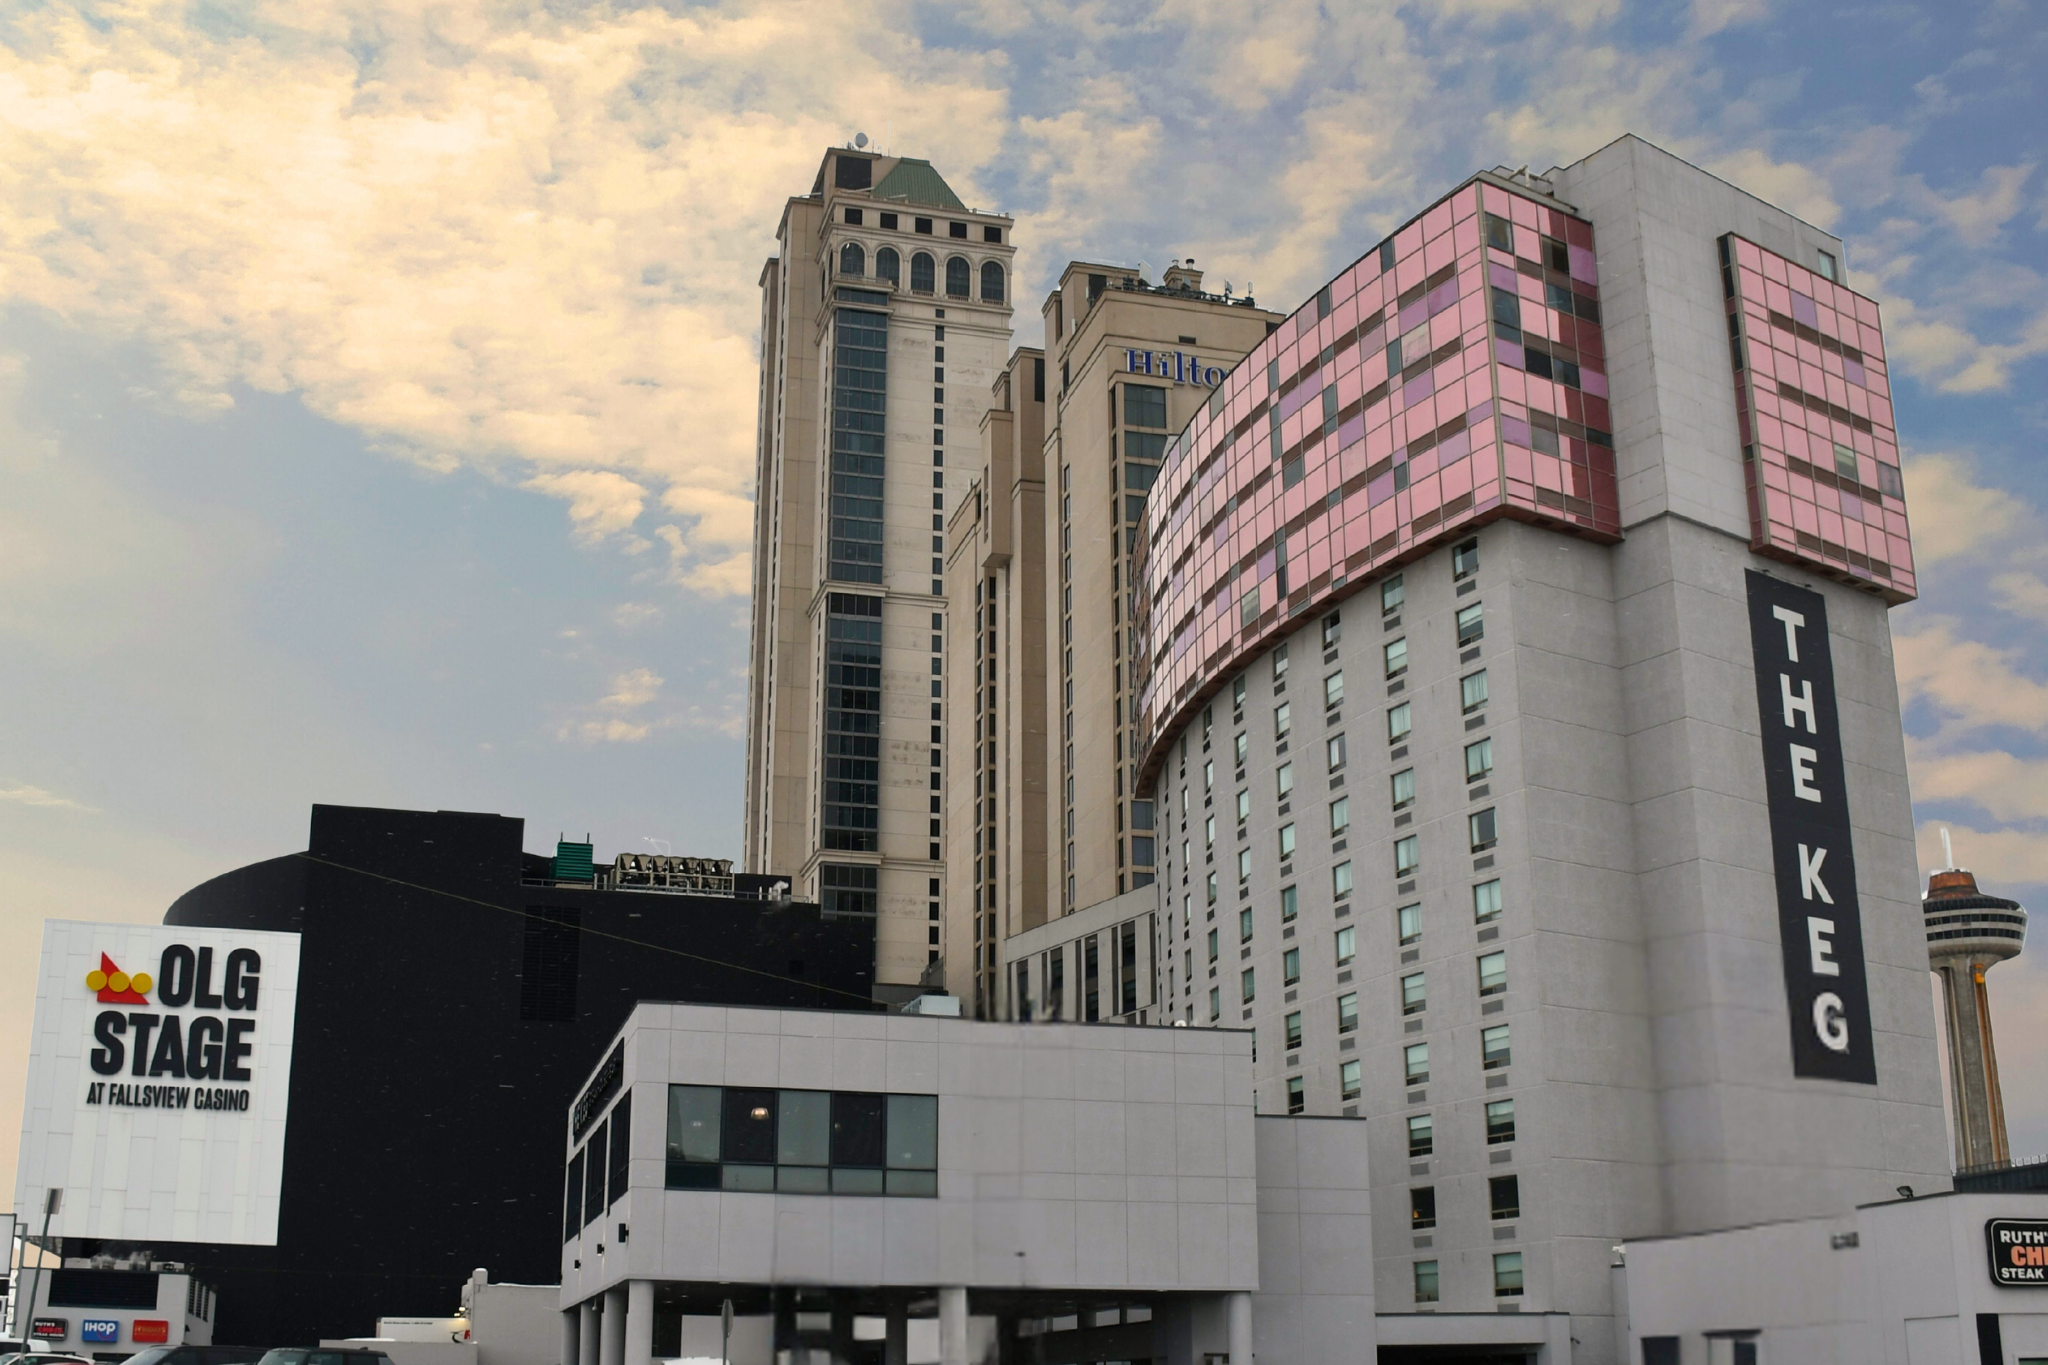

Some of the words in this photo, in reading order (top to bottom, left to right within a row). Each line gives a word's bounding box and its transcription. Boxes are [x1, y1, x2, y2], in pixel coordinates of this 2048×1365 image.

[1124, 349, 1231, 390] Hilto
[1772, 604, 1822, 803] THE
[1798, 843, 1850, 1053] KEG
[158, 944, 261, 1010] OLG
[90, 1010, 256, 1082] STAGE
[86, 1082, 106, 1104] AT
[108, 1083, 191, 1109] FALLSVIEW
[194, 1086, 250, 1111] CASINO
[2000, 1230, 2048, 1244] RUTH'
[2001, 1267, 2045, 1279] STEAK
[84, 1322, 116, 1335] IHOP
